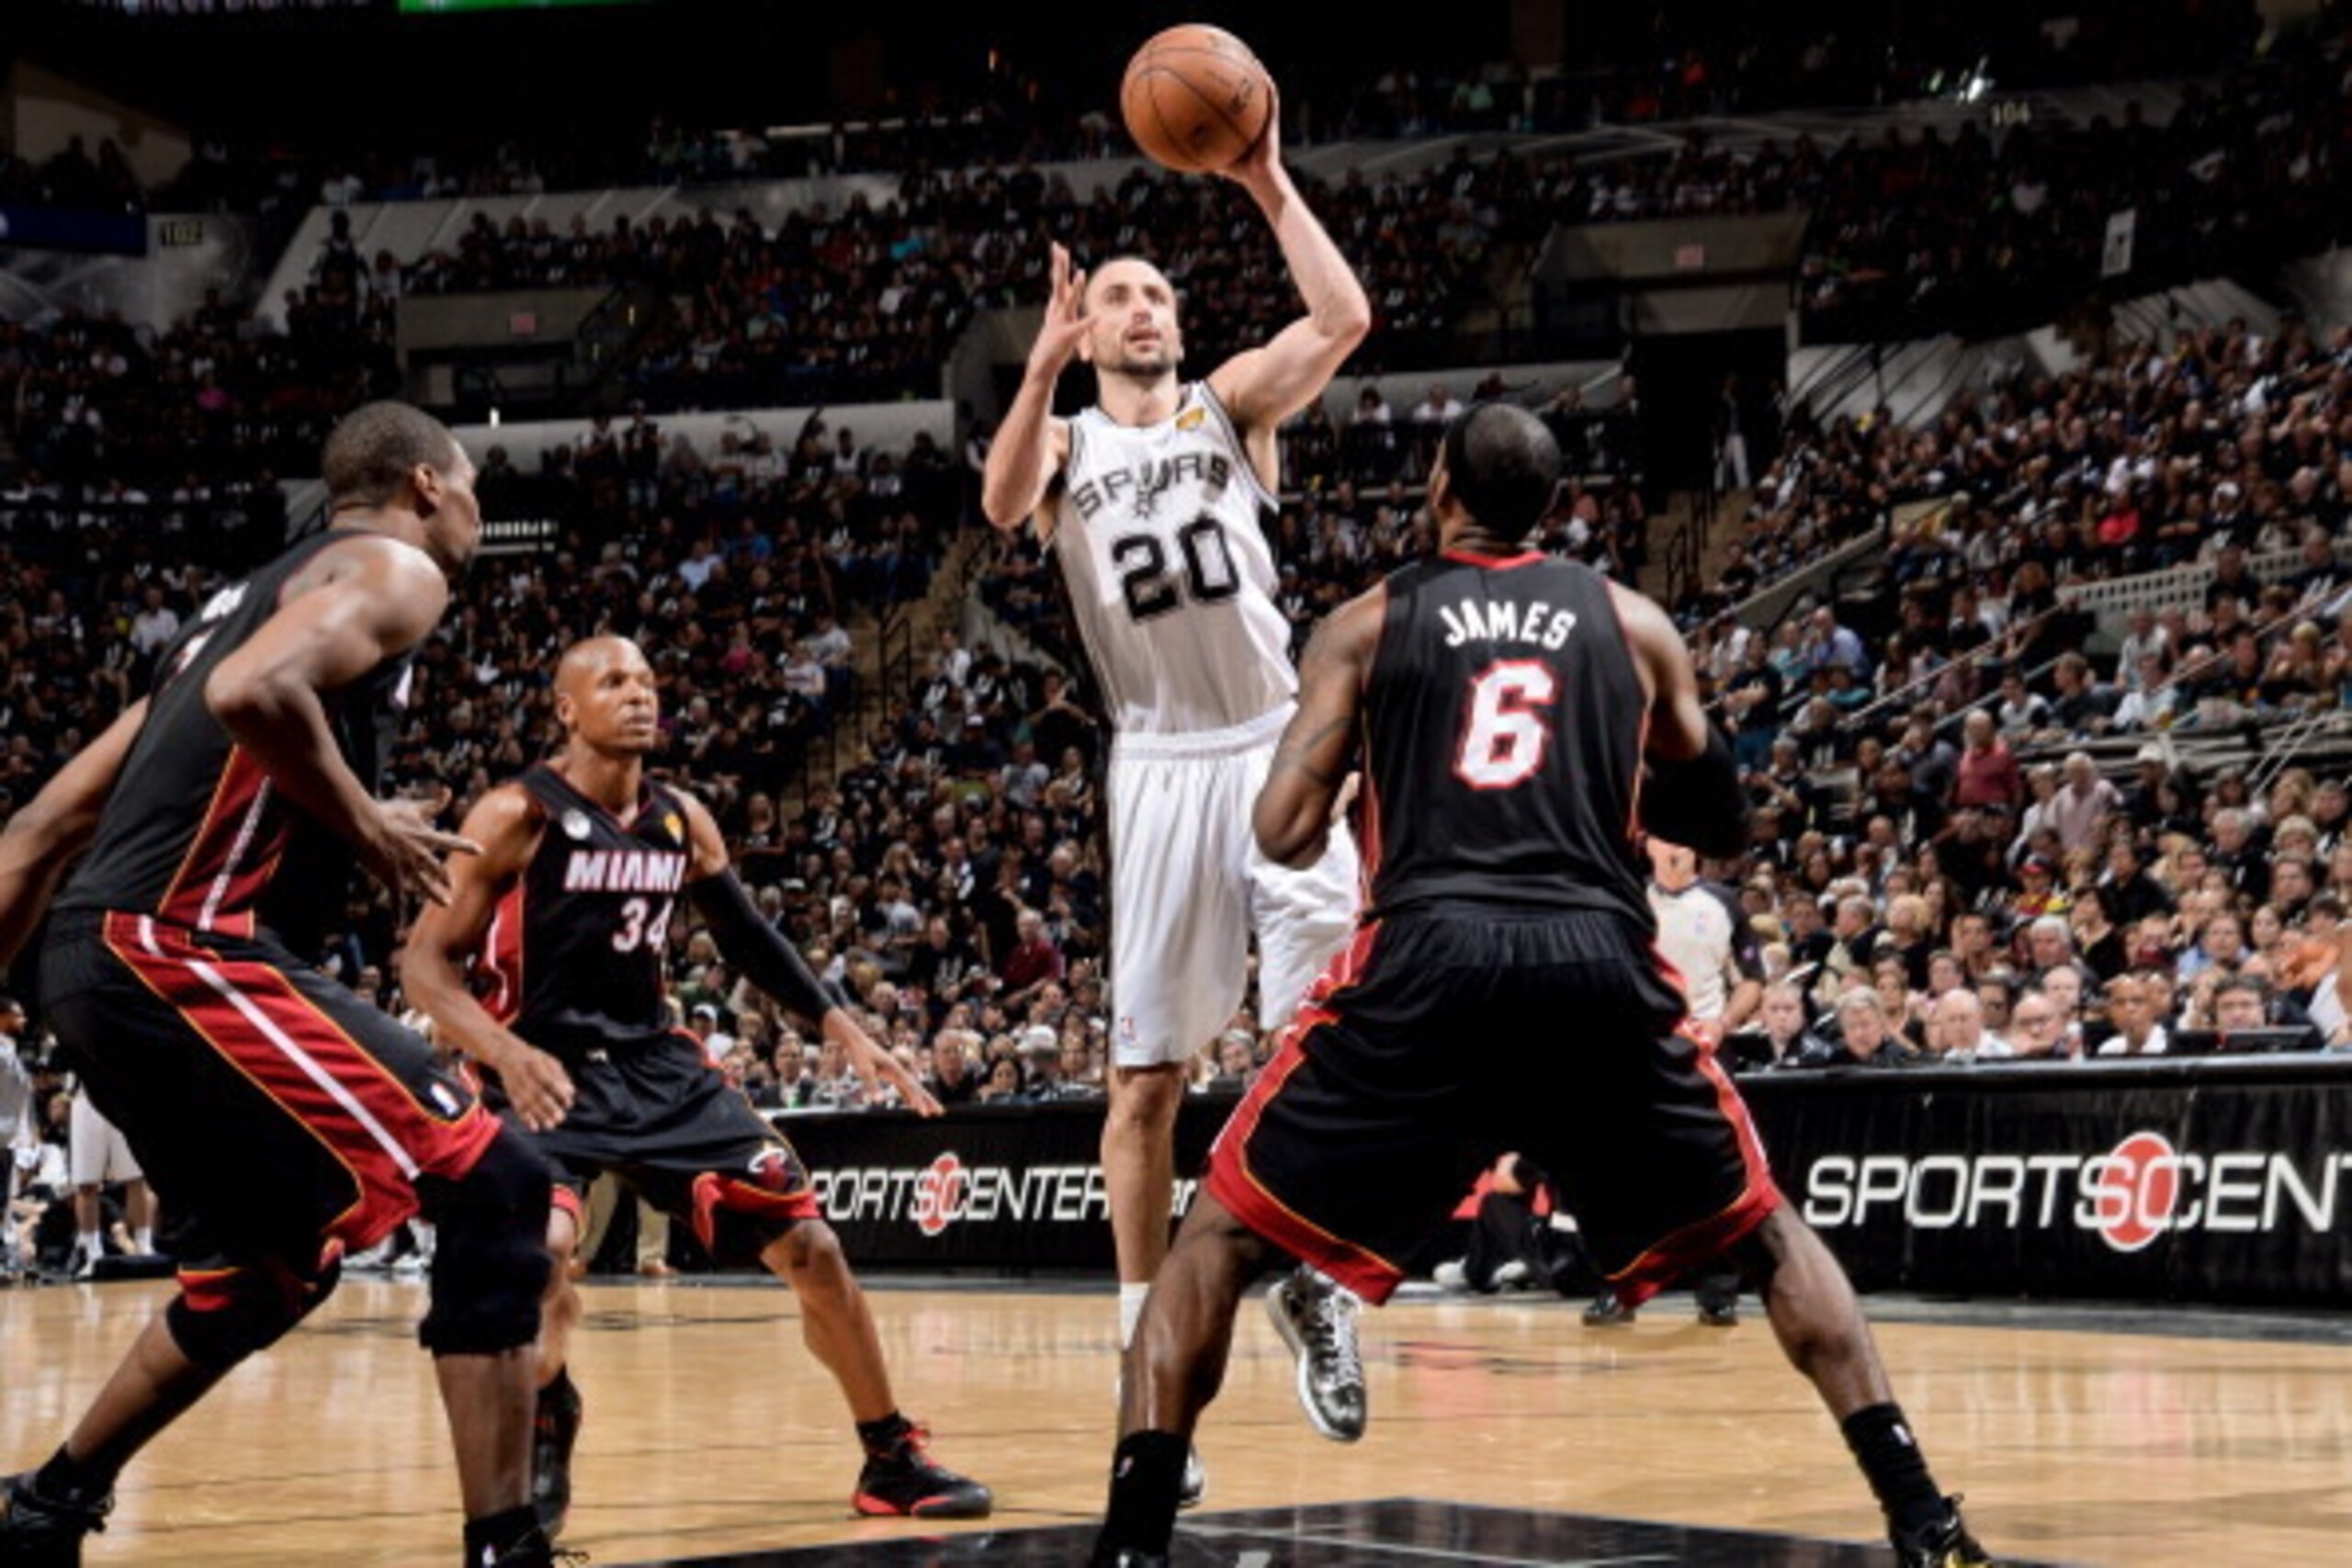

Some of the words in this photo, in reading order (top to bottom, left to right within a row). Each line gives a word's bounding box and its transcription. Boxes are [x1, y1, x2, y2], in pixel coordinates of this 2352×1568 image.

[1071, 450, 1231, 522] SPURS
[1112, 512, 1240, 624] 20
[1439, 597, 1577, 650] JAMES
[1453, 659, 1564, 792] 6
[563, 851, 687, 892] MIAMI
[613, 897, 674, 953] 34
[810, 1168, 1111, 1221] PORTSCENTER
